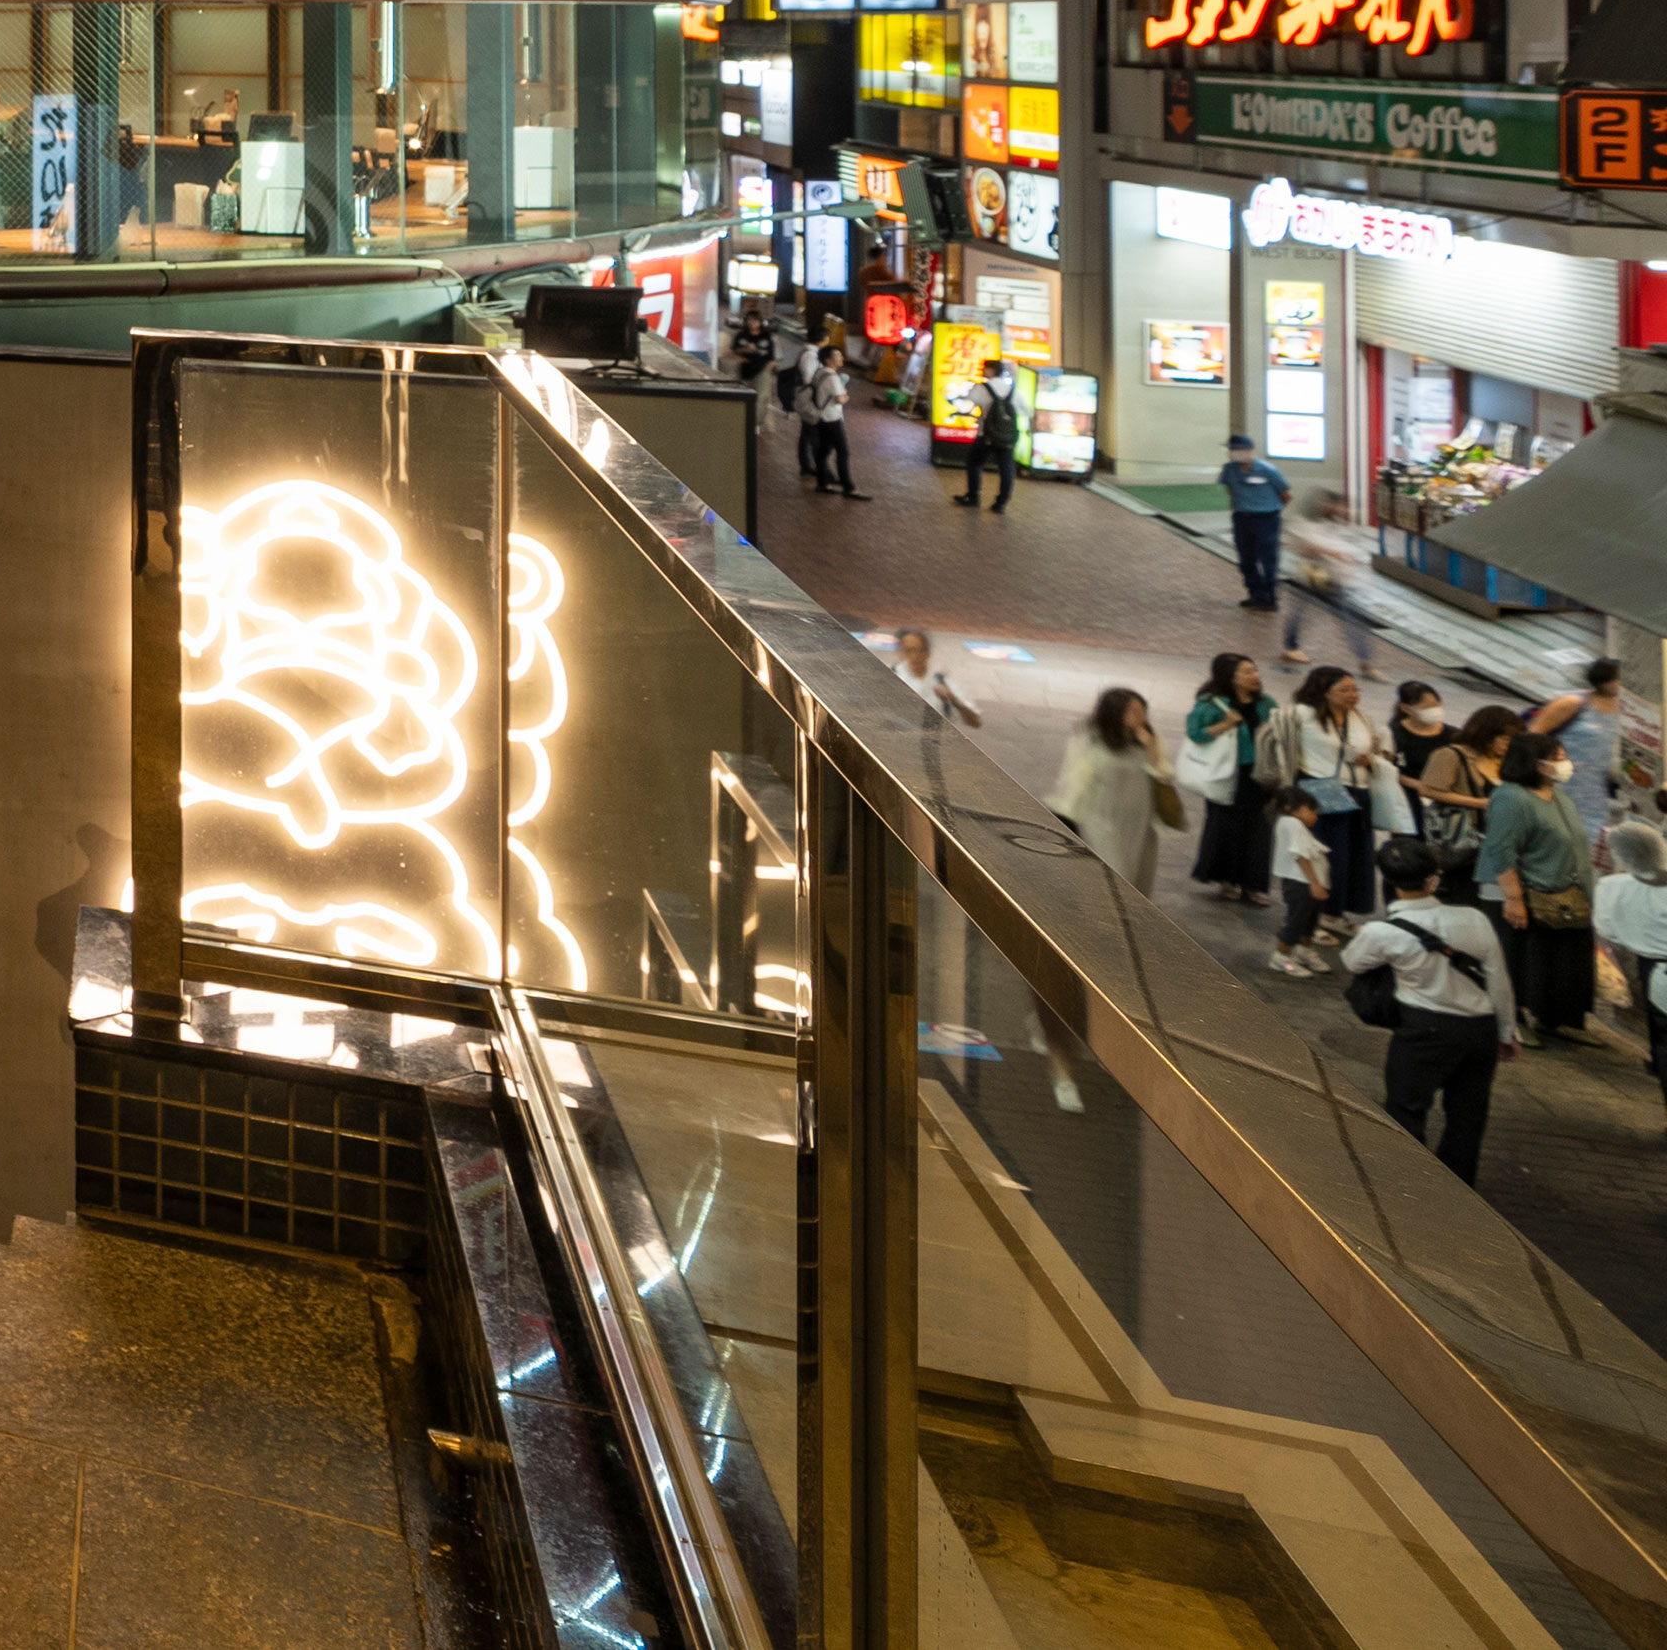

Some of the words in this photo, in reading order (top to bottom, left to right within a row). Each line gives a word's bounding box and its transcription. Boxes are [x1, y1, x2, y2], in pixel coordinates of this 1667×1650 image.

[1231, 92, 1376, 144] KOMEDA'S
[1385, 102, 1498, 158] Coffee
[1590, 106, 1629, 173] 2F
